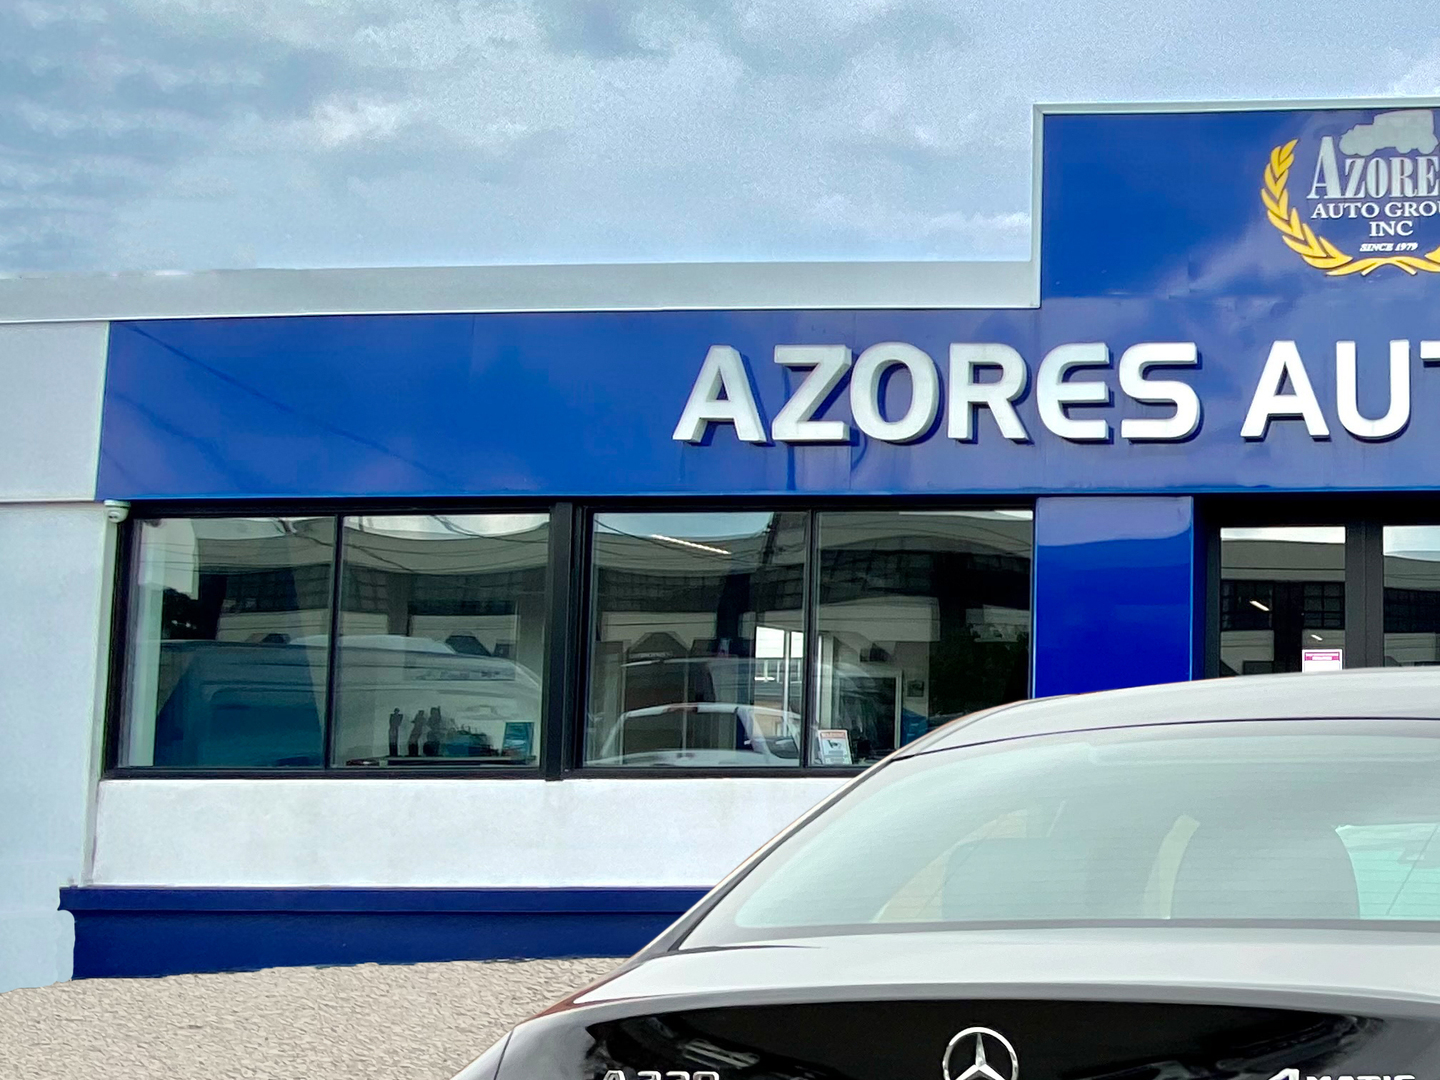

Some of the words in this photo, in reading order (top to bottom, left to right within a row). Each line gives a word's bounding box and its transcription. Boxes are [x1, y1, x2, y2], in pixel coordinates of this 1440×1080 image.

[1311, 202, 1379, 219] AUTO
[1369, 220, 1413, 237] INC
[1360, 242, 1393, 252] SINCE
[1395, 241, 1418, 251] 1979
[672, 340, 1201, 444] AZORES
